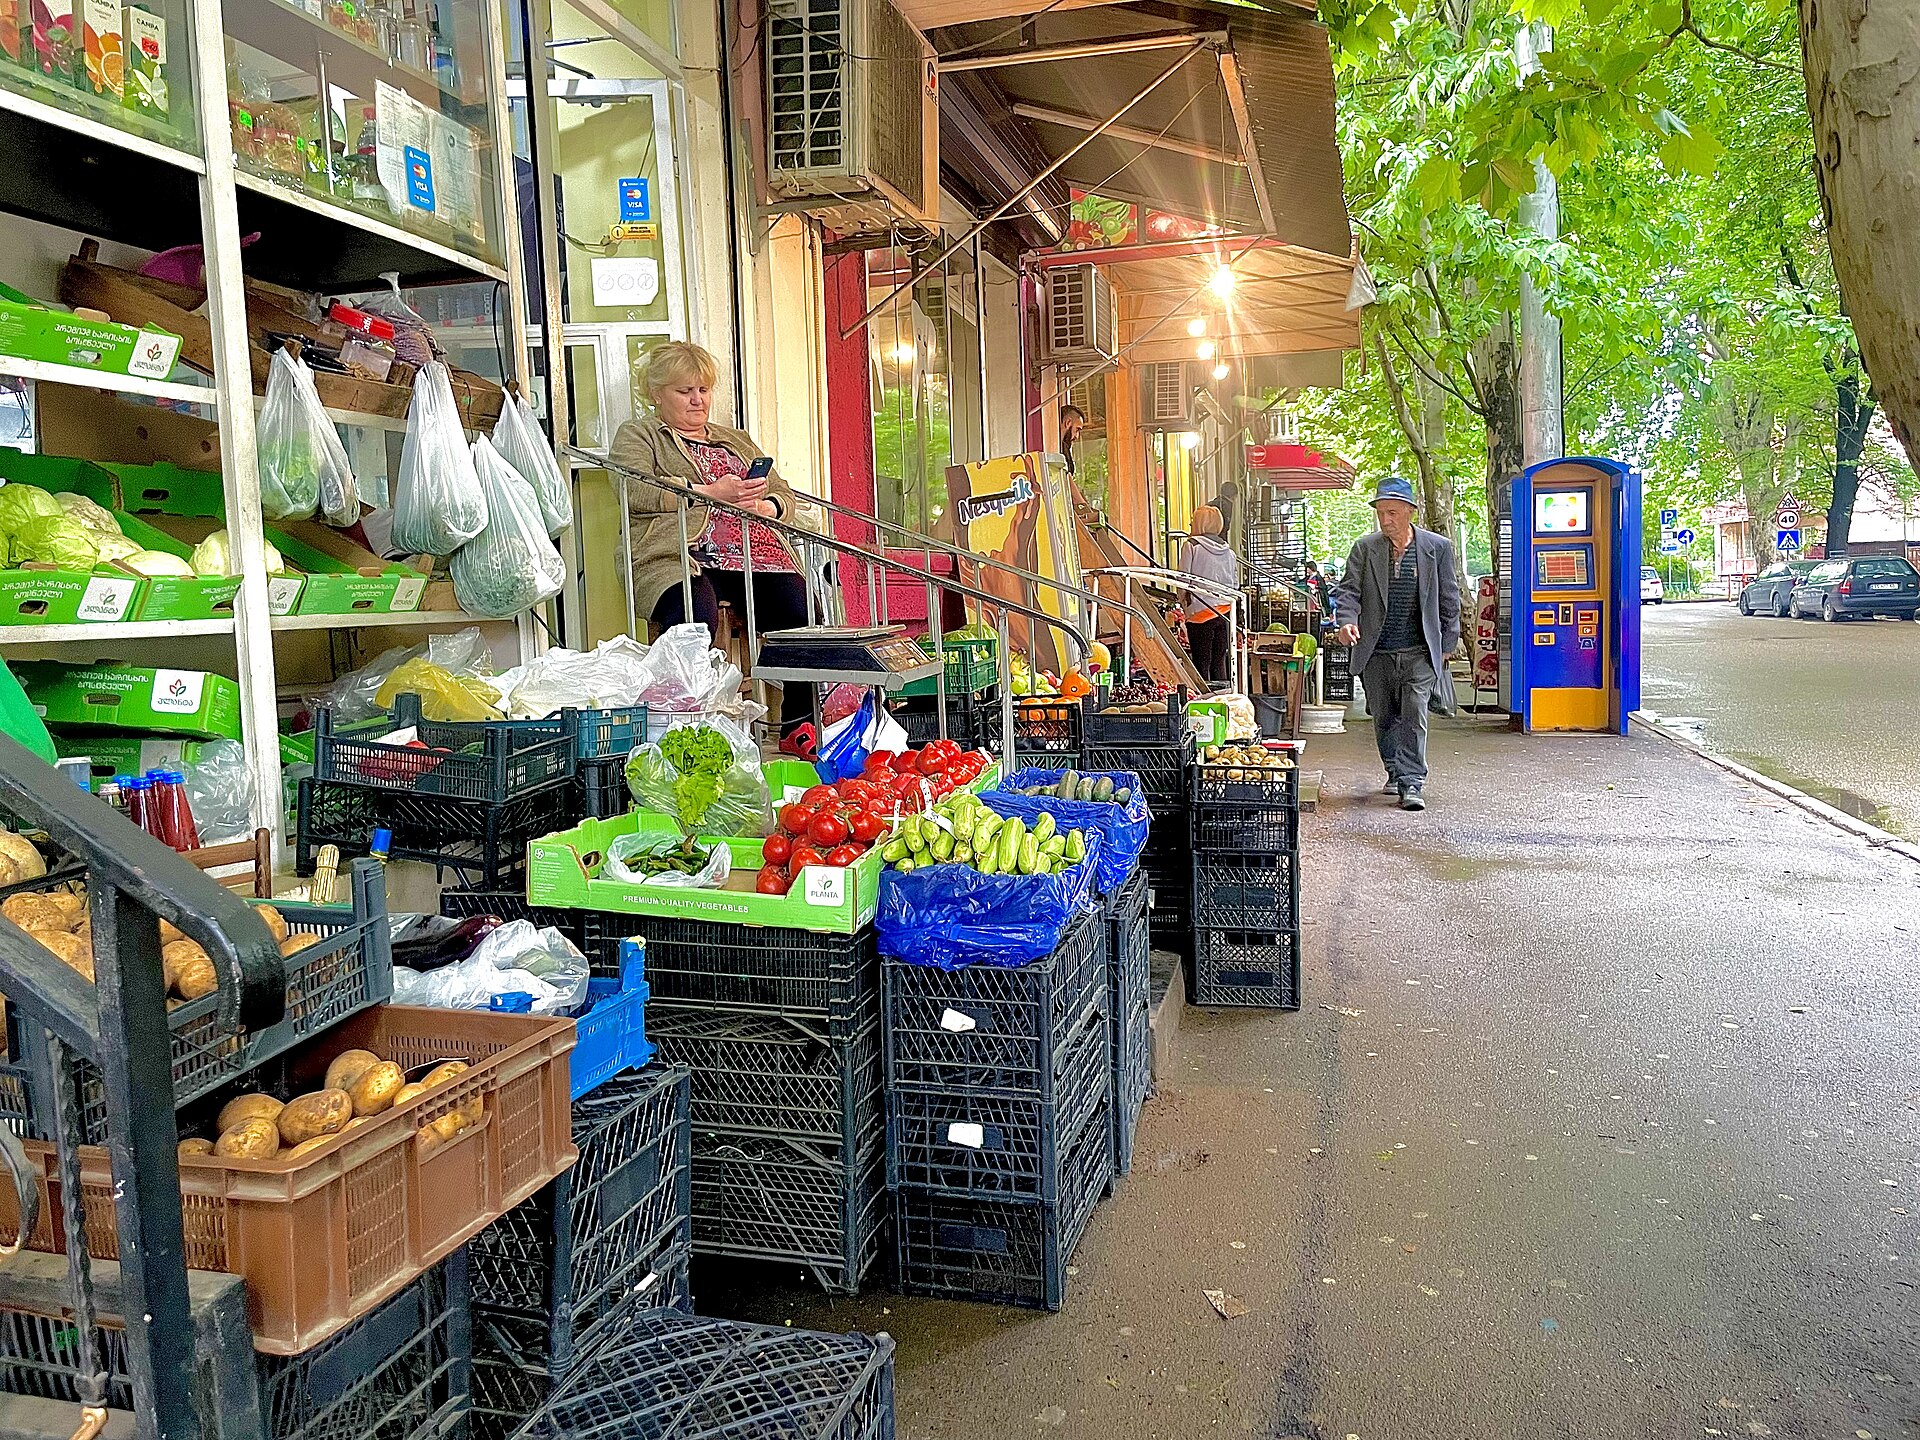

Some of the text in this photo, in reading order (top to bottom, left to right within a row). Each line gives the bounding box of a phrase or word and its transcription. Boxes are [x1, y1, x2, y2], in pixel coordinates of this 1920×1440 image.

[1664, 511, 1674, 524] P
[1780, 515, 1795, 523] 40
[810, 890, 839, 900] PLANTA
[622, 894, 749, 913] PREMIUM QUALITY VEGETABLES
